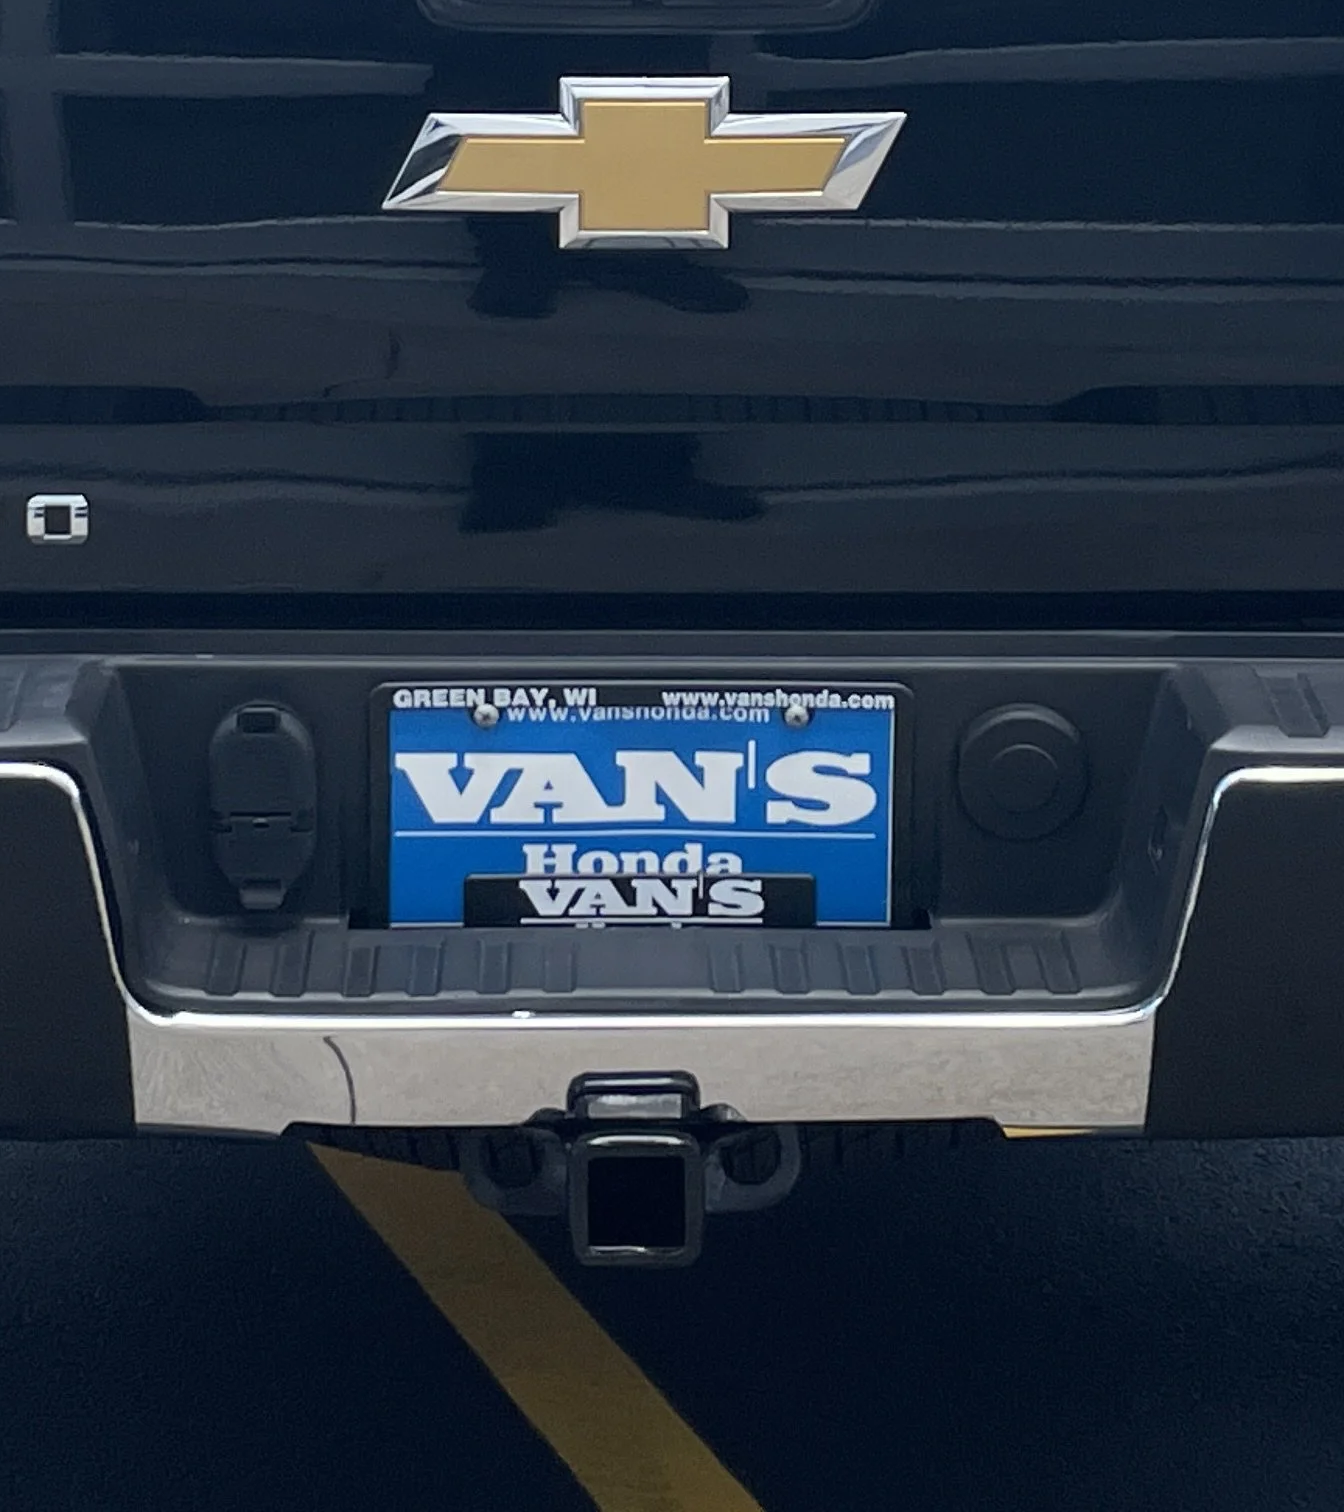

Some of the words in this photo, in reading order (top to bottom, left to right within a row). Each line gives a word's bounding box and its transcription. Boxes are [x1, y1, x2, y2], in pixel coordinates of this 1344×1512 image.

[393, 688, 485, 708] GREEN
[563, 688, 597, 707] WI
[661, 689, 895, 710] www.vanshonda.com
[394, 740, 877, 826] VAN'S
[522, 843, 743, 874] Honda
[519, 872, 764, 917] VAN'S
